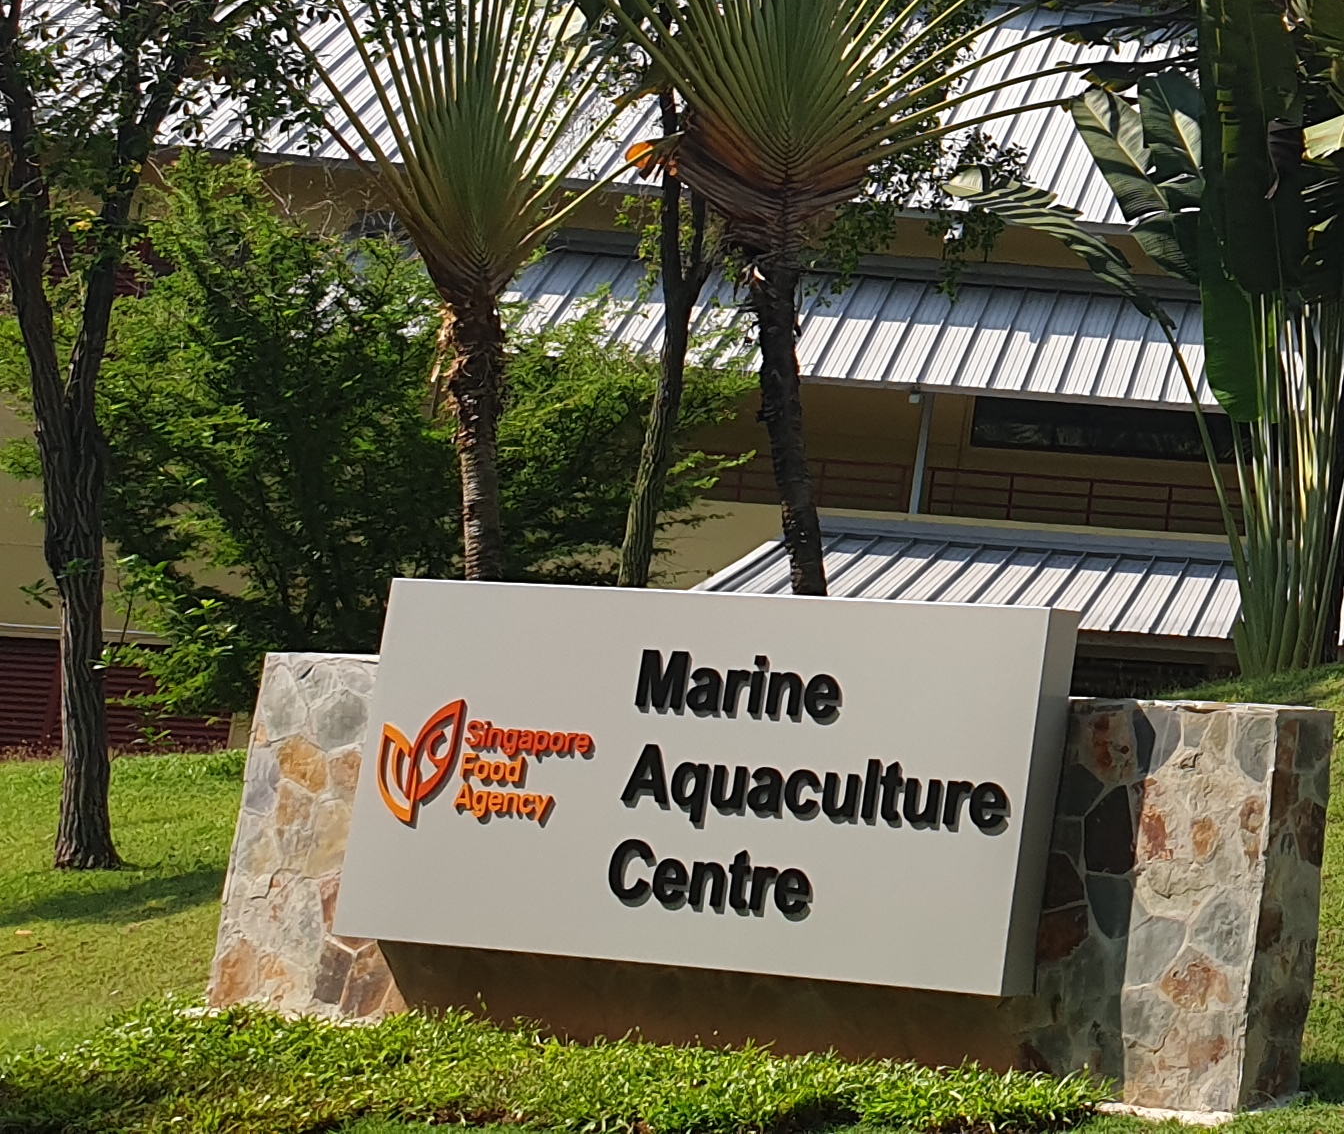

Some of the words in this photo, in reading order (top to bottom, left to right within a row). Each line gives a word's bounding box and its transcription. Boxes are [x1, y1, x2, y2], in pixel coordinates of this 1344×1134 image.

[635, 650, 839, 724] Marine
[465, 718, 593, 758] Singapore
[461, 753, 525, 784] Food
[621, 744, 1008, 835] Aquaculture
[454, 783, 552, 823] Agency
[609, 839, 810, 920] Centre
